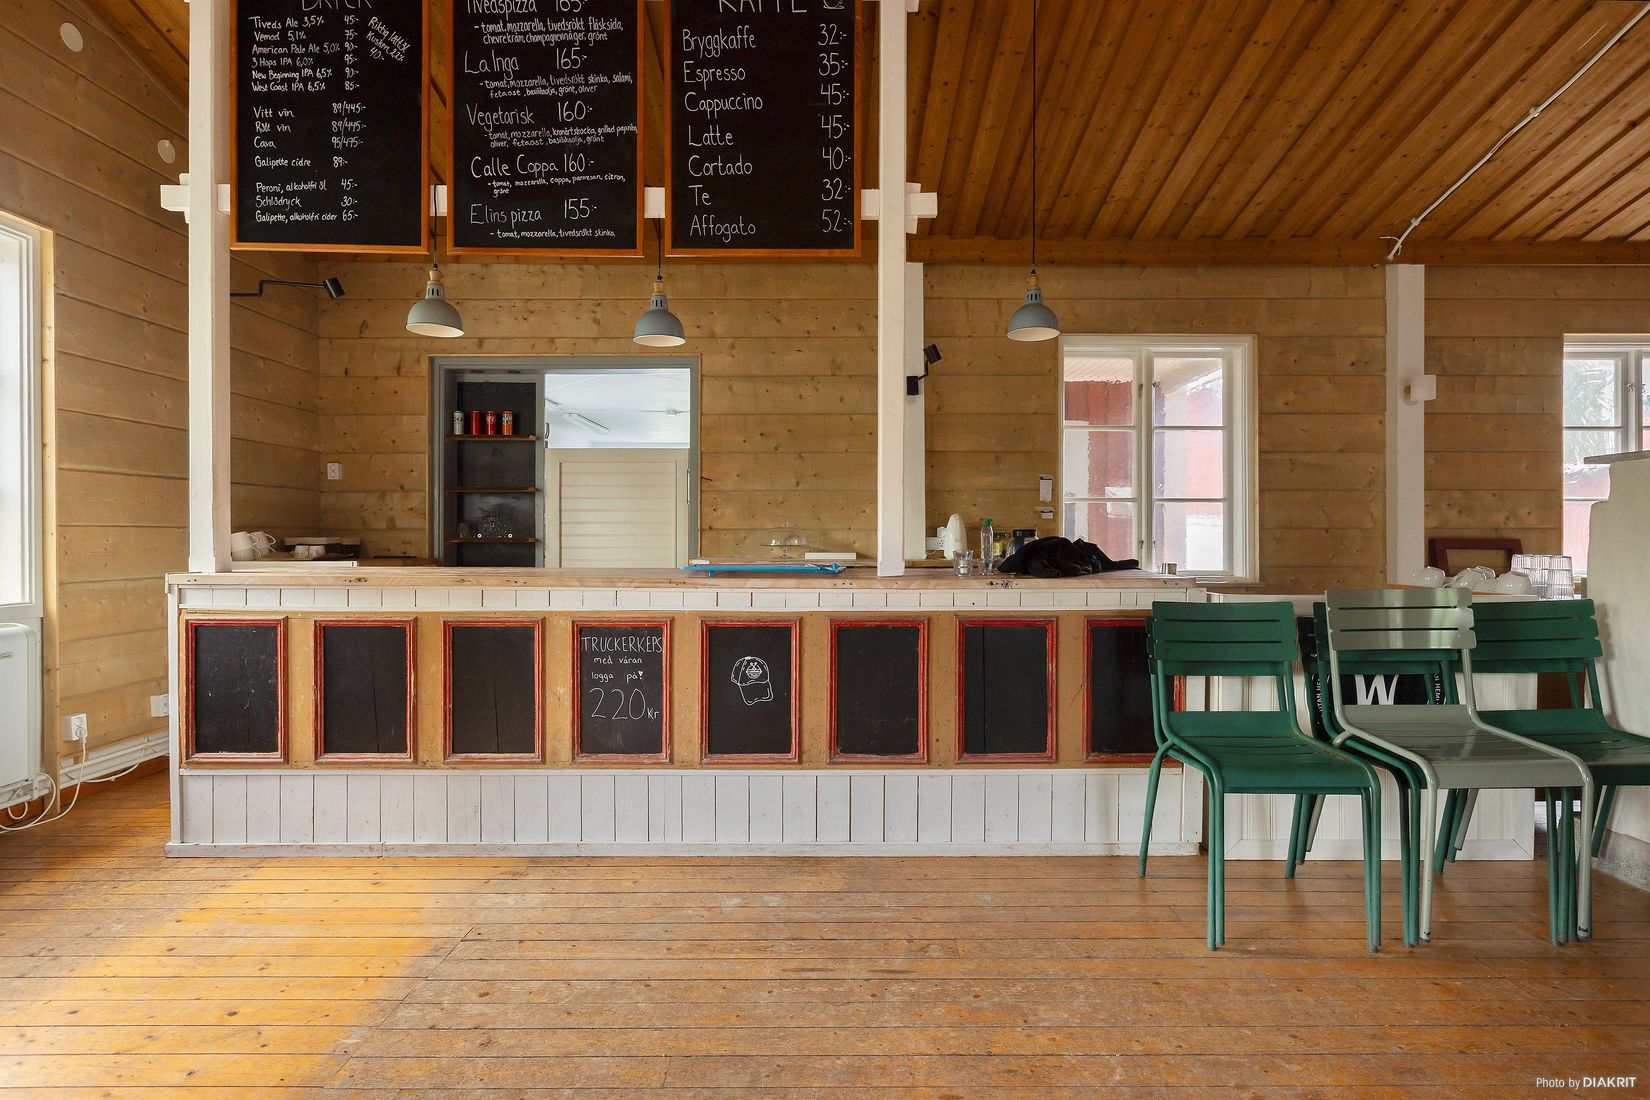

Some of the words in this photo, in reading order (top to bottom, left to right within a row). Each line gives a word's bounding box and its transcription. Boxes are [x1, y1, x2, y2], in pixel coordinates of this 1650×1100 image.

[248, 16, 282, 29] Tiveds
[286, 17, 299, 27] Ale
[302, 15, 324, 27] 3,5%
[368, 16, 389, 40] Riktig
[254, 31, 280, 41] Vemod
[287, 31, 306, 42] 5,1%
[366, 31, 390, 54] Kusken
[588, 32, 608, 46] grönt
[682, 25, 757, 59] Bryggkaffe
[817, 24, 847, 45] 32:-
[252, 44, 288, 55] American
[291, 44, 306, 54] Pale
[308, 43, 320, 54] Ale
[323, 42, 340, 54] 5,0%
[252, 57, 258, 68] 3
[259, 57, 277, 68] Hops
[280, 57, 293, 66] IPA
[296, 57, 314, 67] 6,0%
[465, 50, 490, 73] La
[492, 49, 519, 80] Inga
[252, 70, 267, 79] New
[268, 70, 299, 83] Beginning
[301, 68, 314, 78] IPA
[316, 68, 333, 79] 6,5%
[683, 61, 746, 90] Espresso
[818, 53, 849, 76] 35:-
[252, 81, 268, 92] West
[270, 82, 288, 91] Coast
[291, 83, 304, 92] IPA
[307, 81, 326, 92] 6,5%
[578, 85, 598, 93] oliver
[684, 92, 763, 119] Cappuccino
[820, 83, 850, 105] 45:-
[253, 106, 273, 119] Vitt
[278, 108, 295, 118] vin
[466, 103, 535, 132] Vegetarisk
[558, 101, 593, 122] 160:-
[276, 123, 292, 133] vin
[688, 125, 734, 146] Latte
[821, 115, 850, 138] 45:-
[253, 136, 277, 149] Cava
[254, 155, 288, 169] Galipette
[291, 158, 311, 167] cidre
[471, 156, 511, 178] Calle
[517, 154, 558, 178] Coppa
[563, 153, 595, 173] 160:-
[688, 153, 753, 176] Cortado
[822, 147, 851, 170] 40:-
[255, 182, 284, 194] Peroni,
[286, 181, 317, 191] alkoholfri
[688, 185, 712, 206] Te
[821, 178, 851, 200] 32:-
[255, 210, 288, 224] Galipette,
[321, 213, 338, 221] cider
[470, 203, 507, 224] Elins
[510, 208, 542, 229] pizza
[564, 198, 597, 220] 155:-
[689, 214, 756, 243] Affogato
[822, 210, 852, 232] 52:-
[581, 635, 663, 653] TRUCKERKEPS
[594, 656, 613, 665] med
[619, 656, 643, 665] våran
[591, 672, 614, 683] logga
